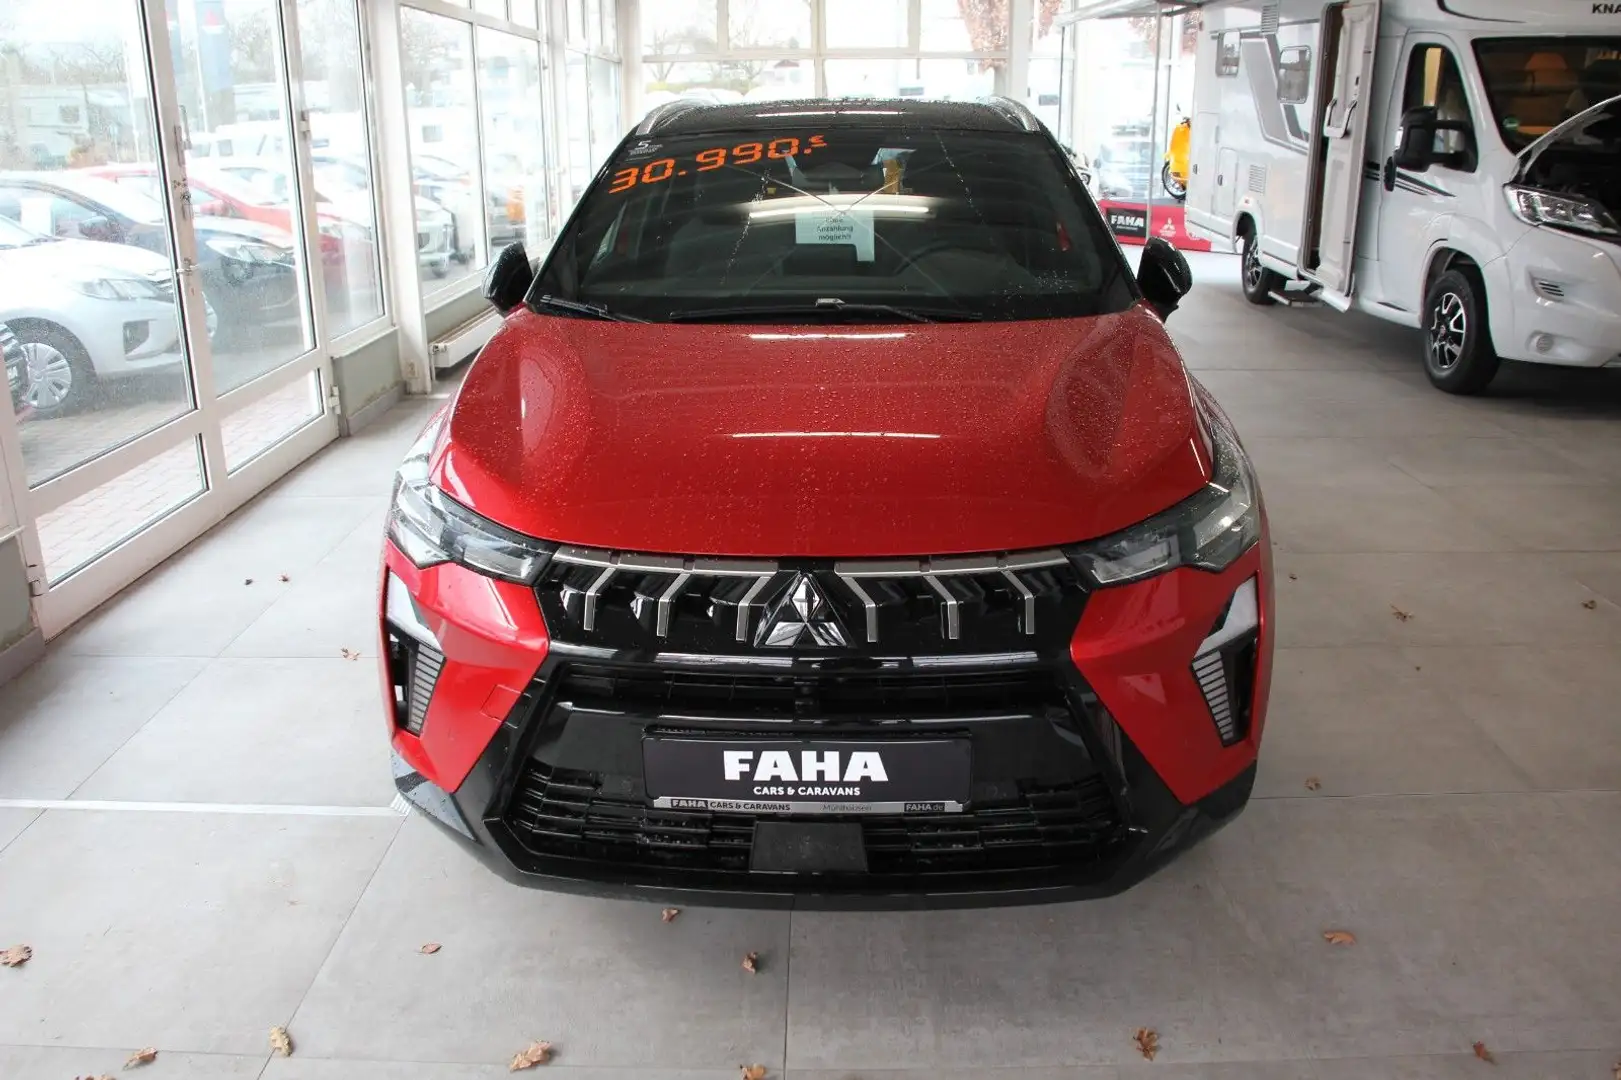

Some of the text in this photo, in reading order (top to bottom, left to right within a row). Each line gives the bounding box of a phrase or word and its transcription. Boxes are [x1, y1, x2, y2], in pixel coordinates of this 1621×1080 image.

[1111, 215, 1144, 228] FAHA
[723, 750, 889, 782] FAHA
[753, 786, 861, 797] CARS & CARAVANS
[671, 800, 706, 808] FAHA
[710, 801, 733, 810] CARS
[743, 802, 791, 811] CARAVANS
